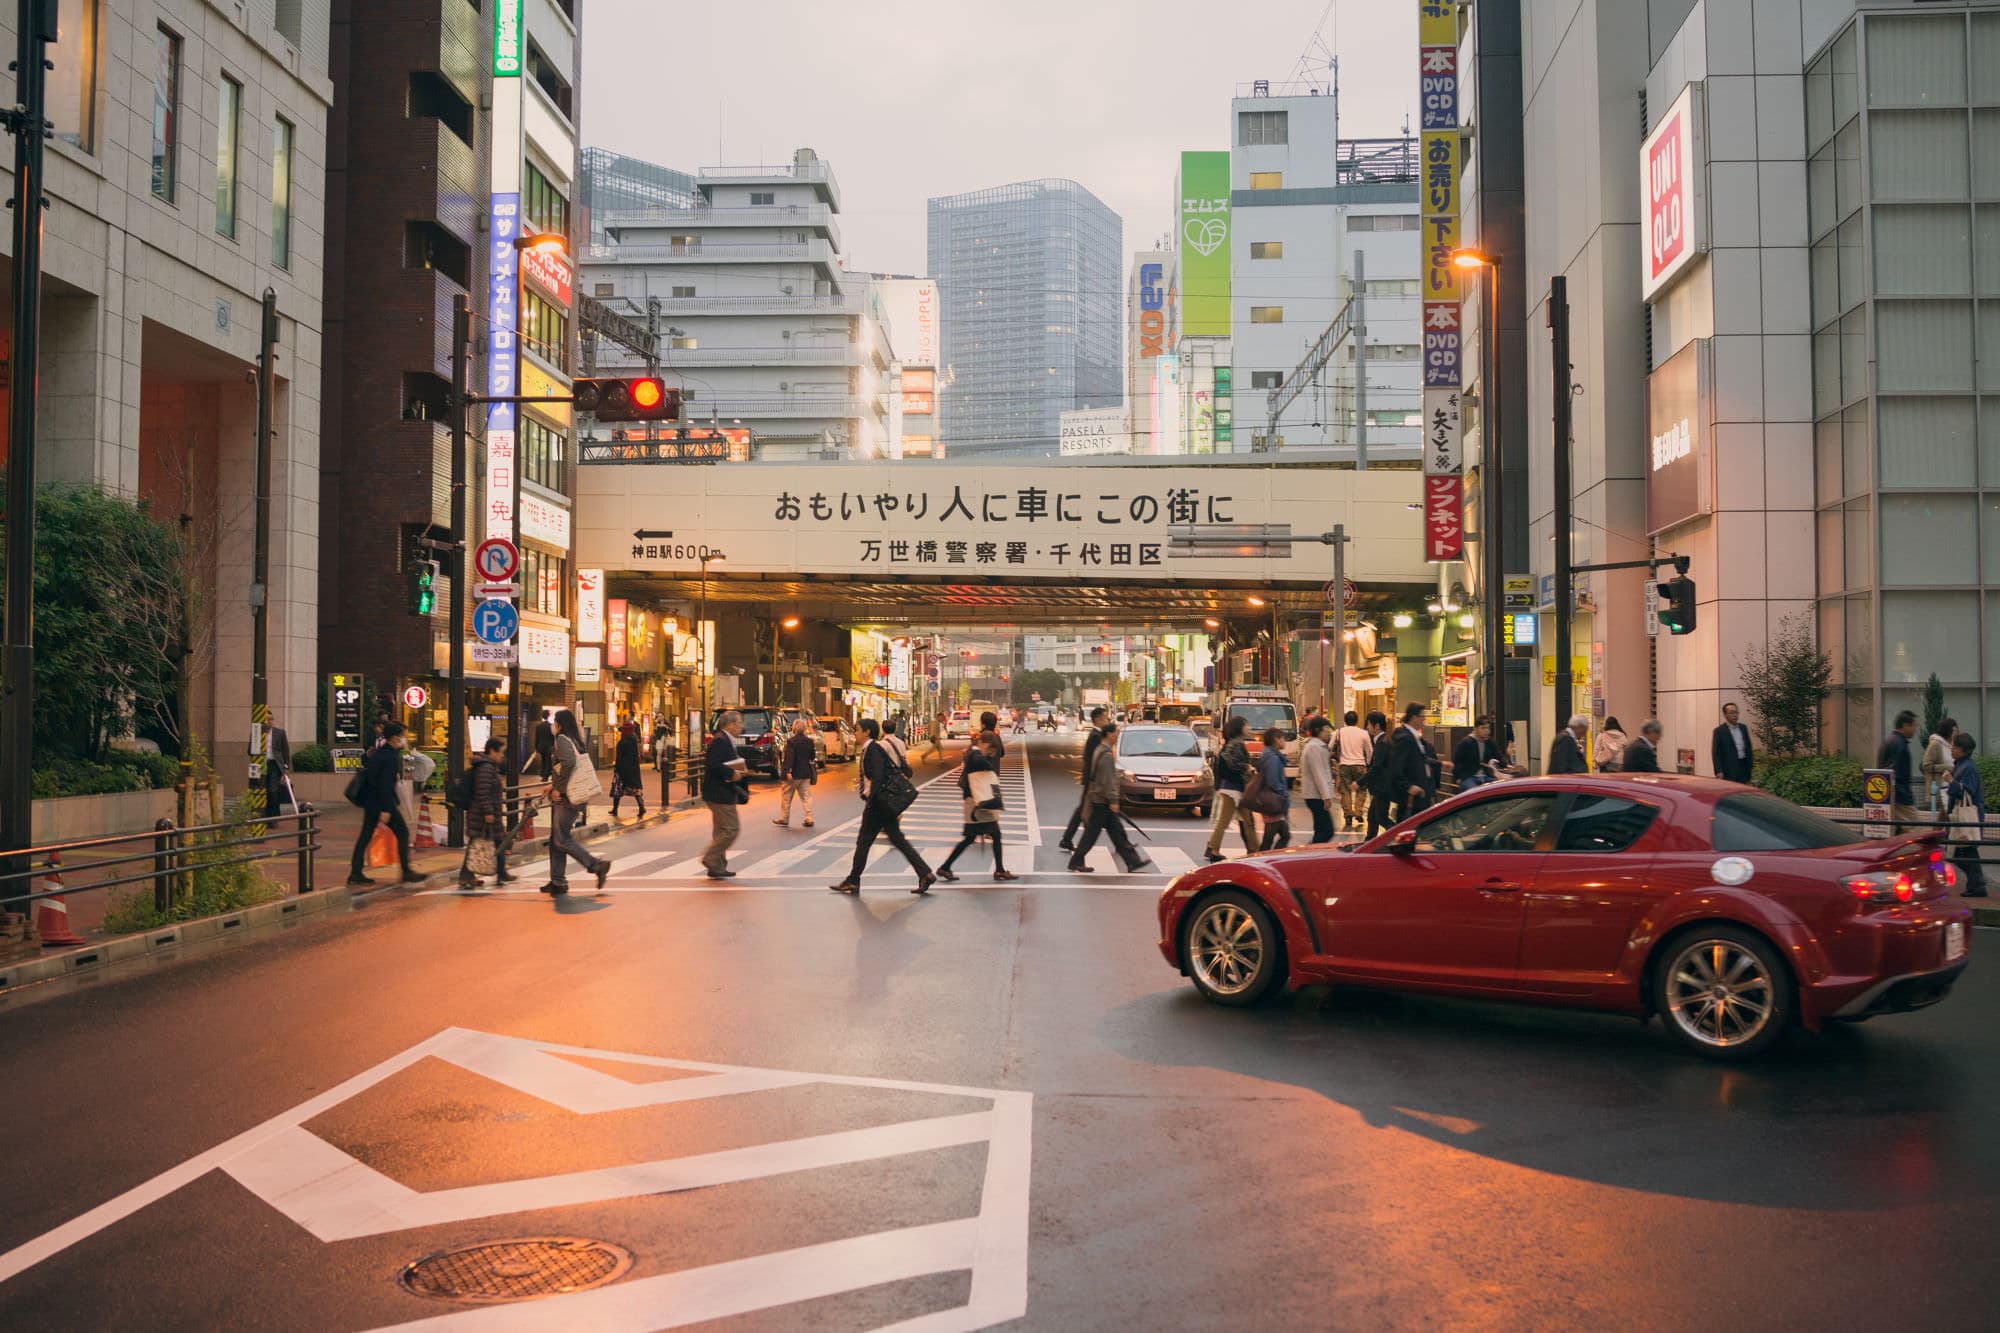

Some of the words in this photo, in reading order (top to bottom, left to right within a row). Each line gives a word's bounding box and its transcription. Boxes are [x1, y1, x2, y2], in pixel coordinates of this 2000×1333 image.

[1423, 49, 1454, 72] 本
[1423, 77, 1455, 92] DVD
[1426, 95, 1453, 109] CD
[1424, 111, 1455, 126] ゲーム
[1652, 136, 1677, 203] UNI
[1653, 193, 1681, 264] QLO
[494, 218, 512, 416] サンメカトロニクス
[1426, 305, 1458, 329] 本
[1426, 334, 1459, 349] DVD
[1429, 351, 1457, 367] CD
[1427, 368, 1459, 383] ゲーム
[1063, 425, 1104, 437] PASELA
[1063, 437, 1112, 451] RESORTS
[1429, 478, 1459, 555] ソフネット
[860, 540, 1162, 565] 万世橋警察署・千代田区
[482, 610, 501, 639] P
[347, 690, 359, 704] P
